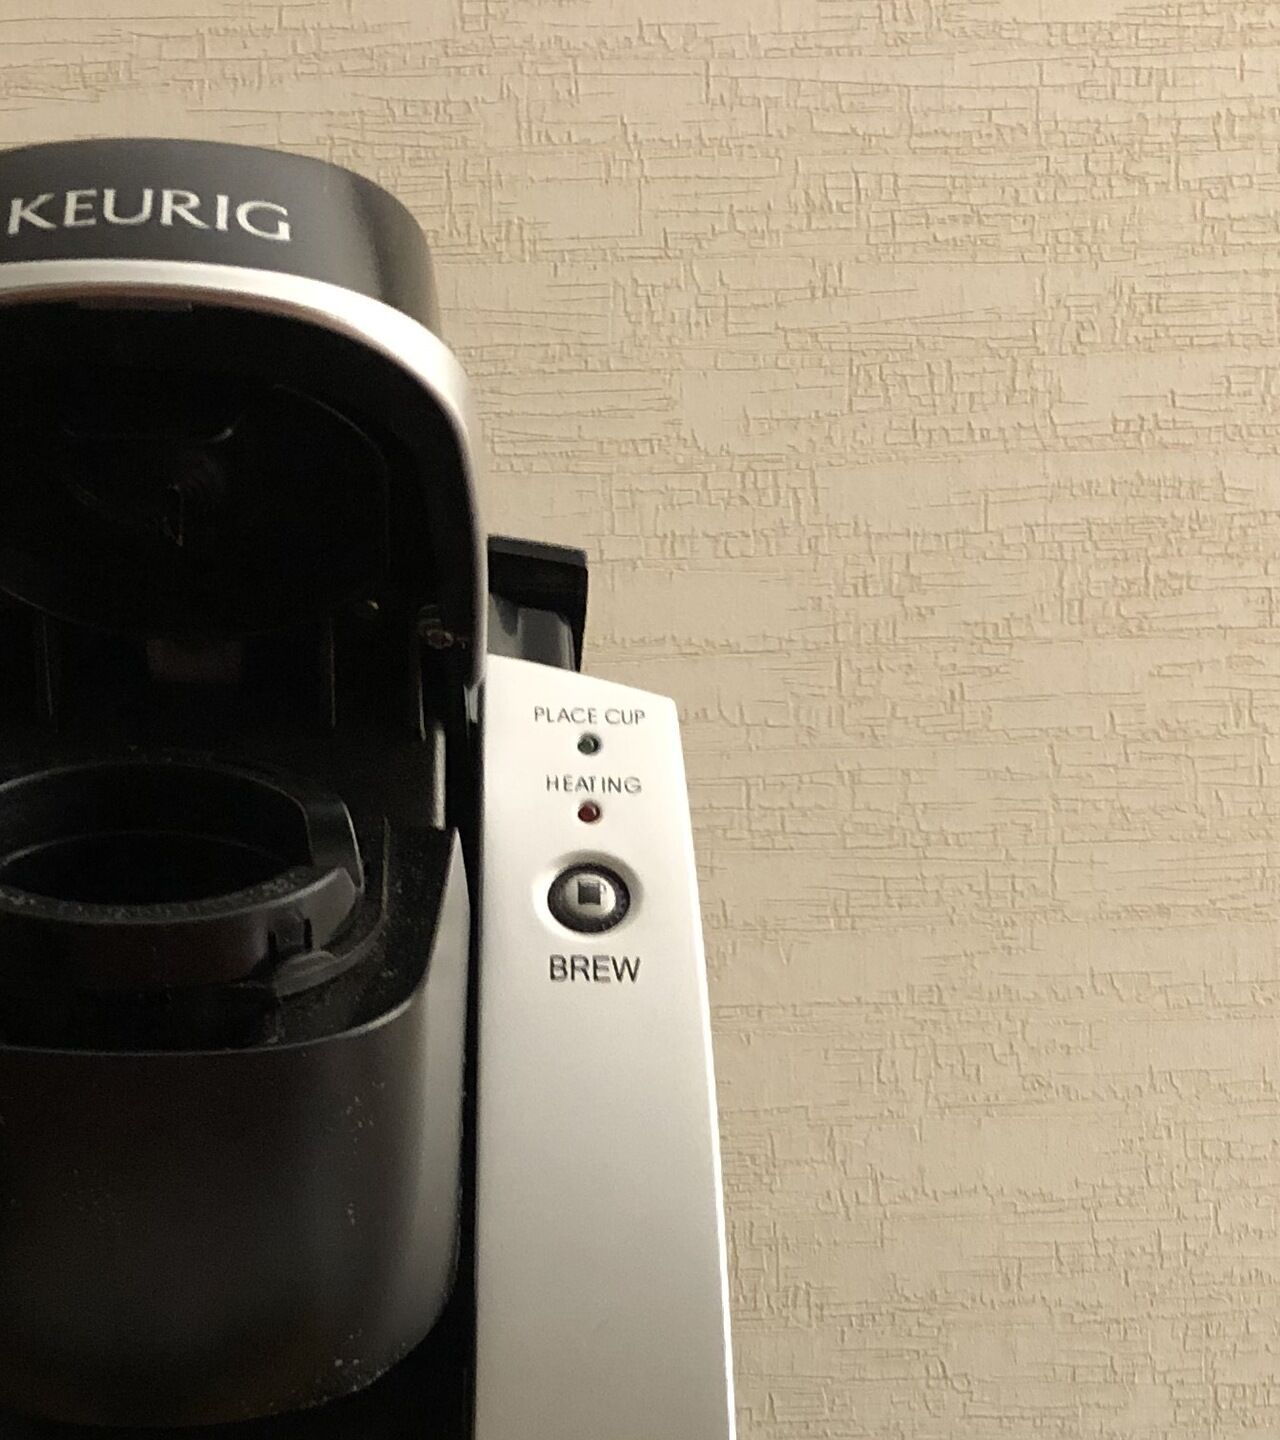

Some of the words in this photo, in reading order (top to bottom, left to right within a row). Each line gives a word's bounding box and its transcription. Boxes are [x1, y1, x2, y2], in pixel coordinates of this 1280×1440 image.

[7, 187, 293, 243] KEURIG
[534, 706, 599, 725] PLACE
[604, 708, 646, 726] CUP
[545, 775, 642, 794] HEATING
[549, 955, 641, 983] BREW
